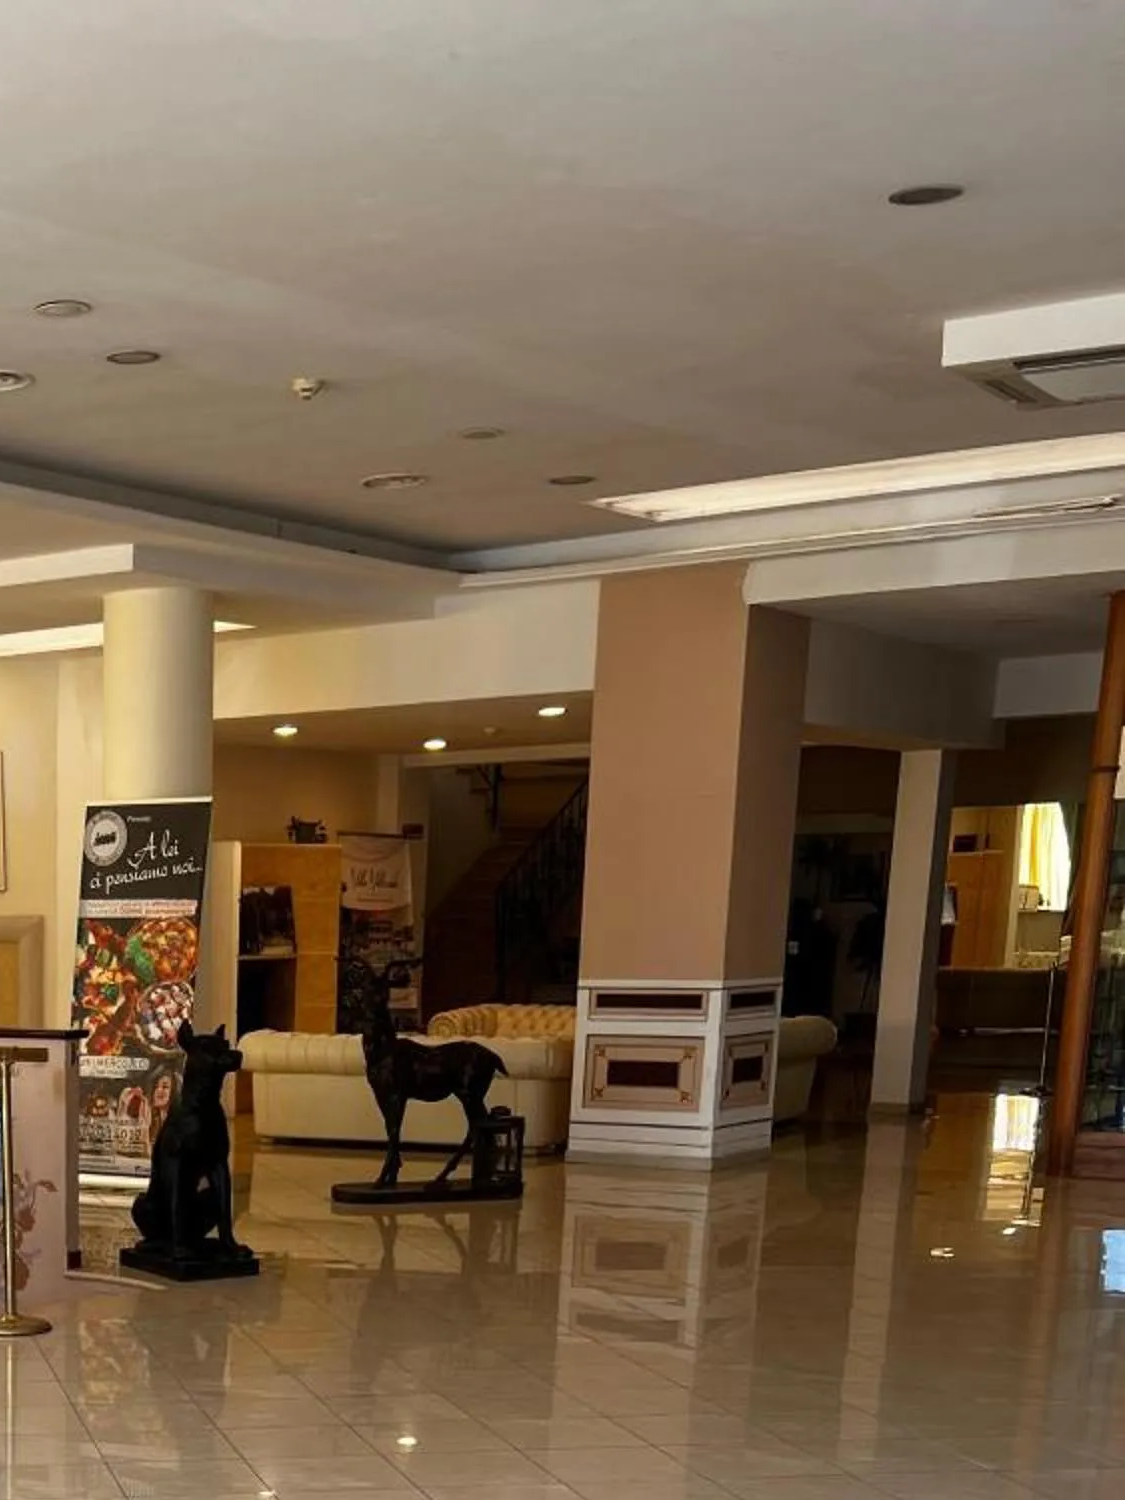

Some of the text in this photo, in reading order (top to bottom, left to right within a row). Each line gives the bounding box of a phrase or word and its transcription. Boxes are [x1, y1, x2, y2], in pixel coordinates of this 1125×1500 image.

[126, 831, 157, 869] A
[161, 829, 179, 857] lei
[106, 866, 168, 895] pensiamo
